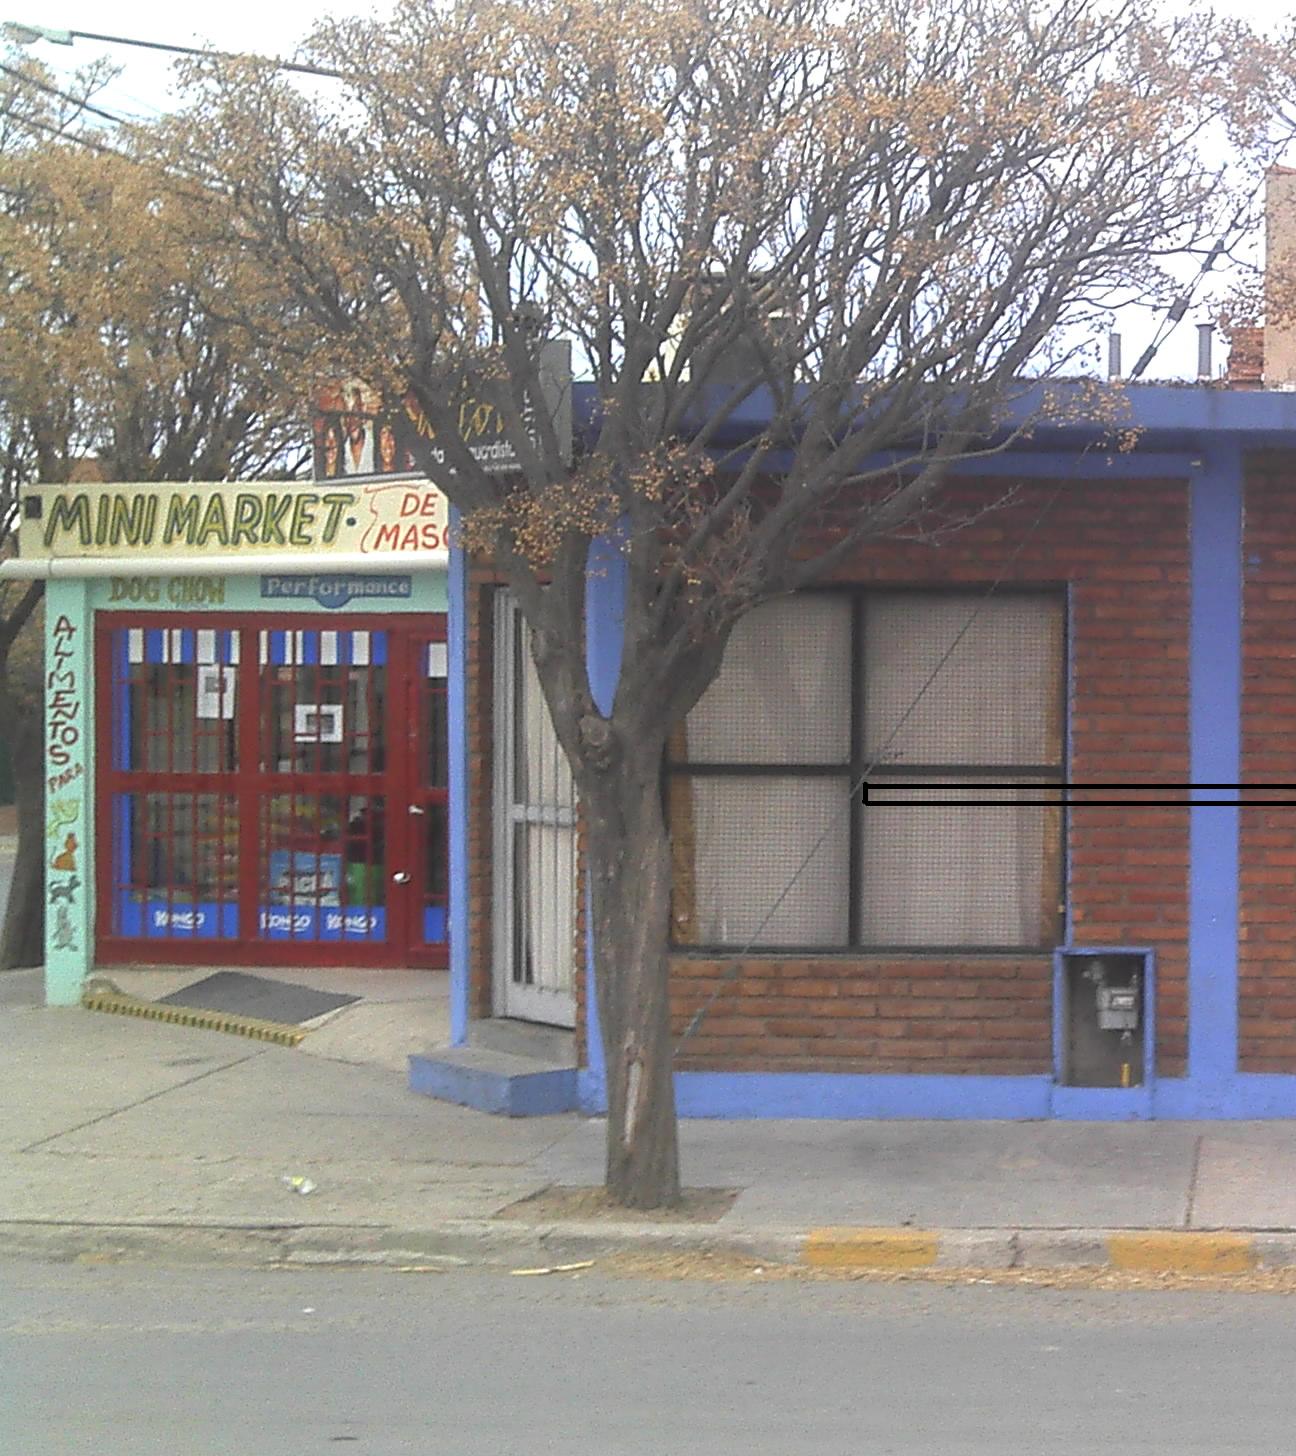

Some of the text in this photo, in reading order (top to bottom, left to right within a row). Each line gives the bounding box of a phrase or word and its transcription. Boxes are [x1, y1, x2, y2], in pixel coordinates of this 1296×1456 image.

[43, 492, 357, 547] MINI MARKET
[400, 493, 438, 517] DE
[109, 575, 226, 604] DOG CHOW
[266, 577, 411, 597] Performance
[48, 615, 80, 766] ALIMENTOS
